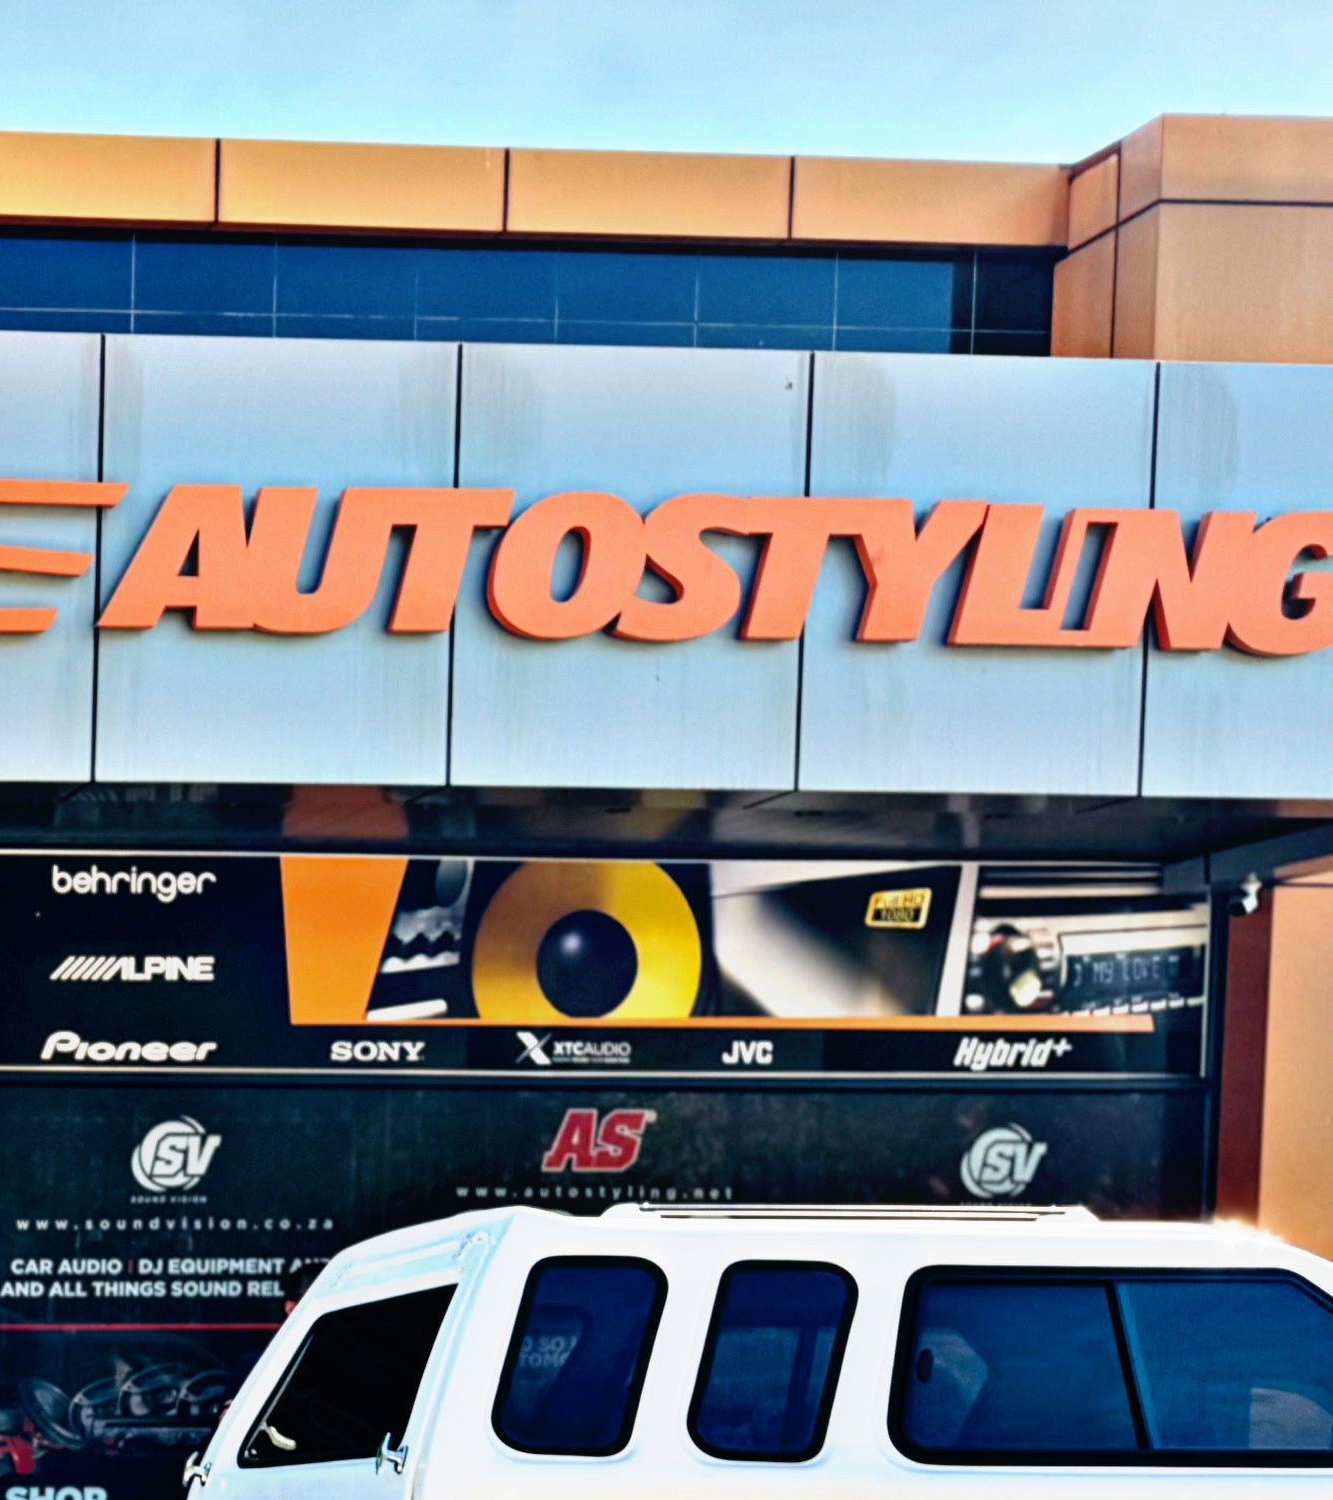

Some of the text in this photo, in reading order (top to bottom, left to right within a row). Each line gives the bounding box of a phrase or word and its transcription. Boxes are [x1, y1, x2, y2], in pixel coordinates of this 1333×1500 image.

[97, 482, 1333, 656] AUTOSTYLING
[51, 864, 218, 904] behringer
[101, 955, 216, 982] ALPINE
[40, 1030, 218, 1062] Pioneer
[330, 1040, 426, 1062] SONY
[721, 1040, 774, 1065] JVC
[953, 1036, 1073, 1072] Hybrid+
[540, 1107, 649, 1172] AS
[455, 1184, 733, 1201] www.autostyling.net
[16, 1216, 335, 1233] www.soundvision.co.za
[10, 1257, 52, 1276] CAR
[57, 1257, 123, 1276] AUDIO
[138, 1257, 162, 1276] DJ
[168, 1256, 285, 1277] EQUIPMENT
[0, 1279, 285, 1299] AND ALL THINGS SOUND REL
